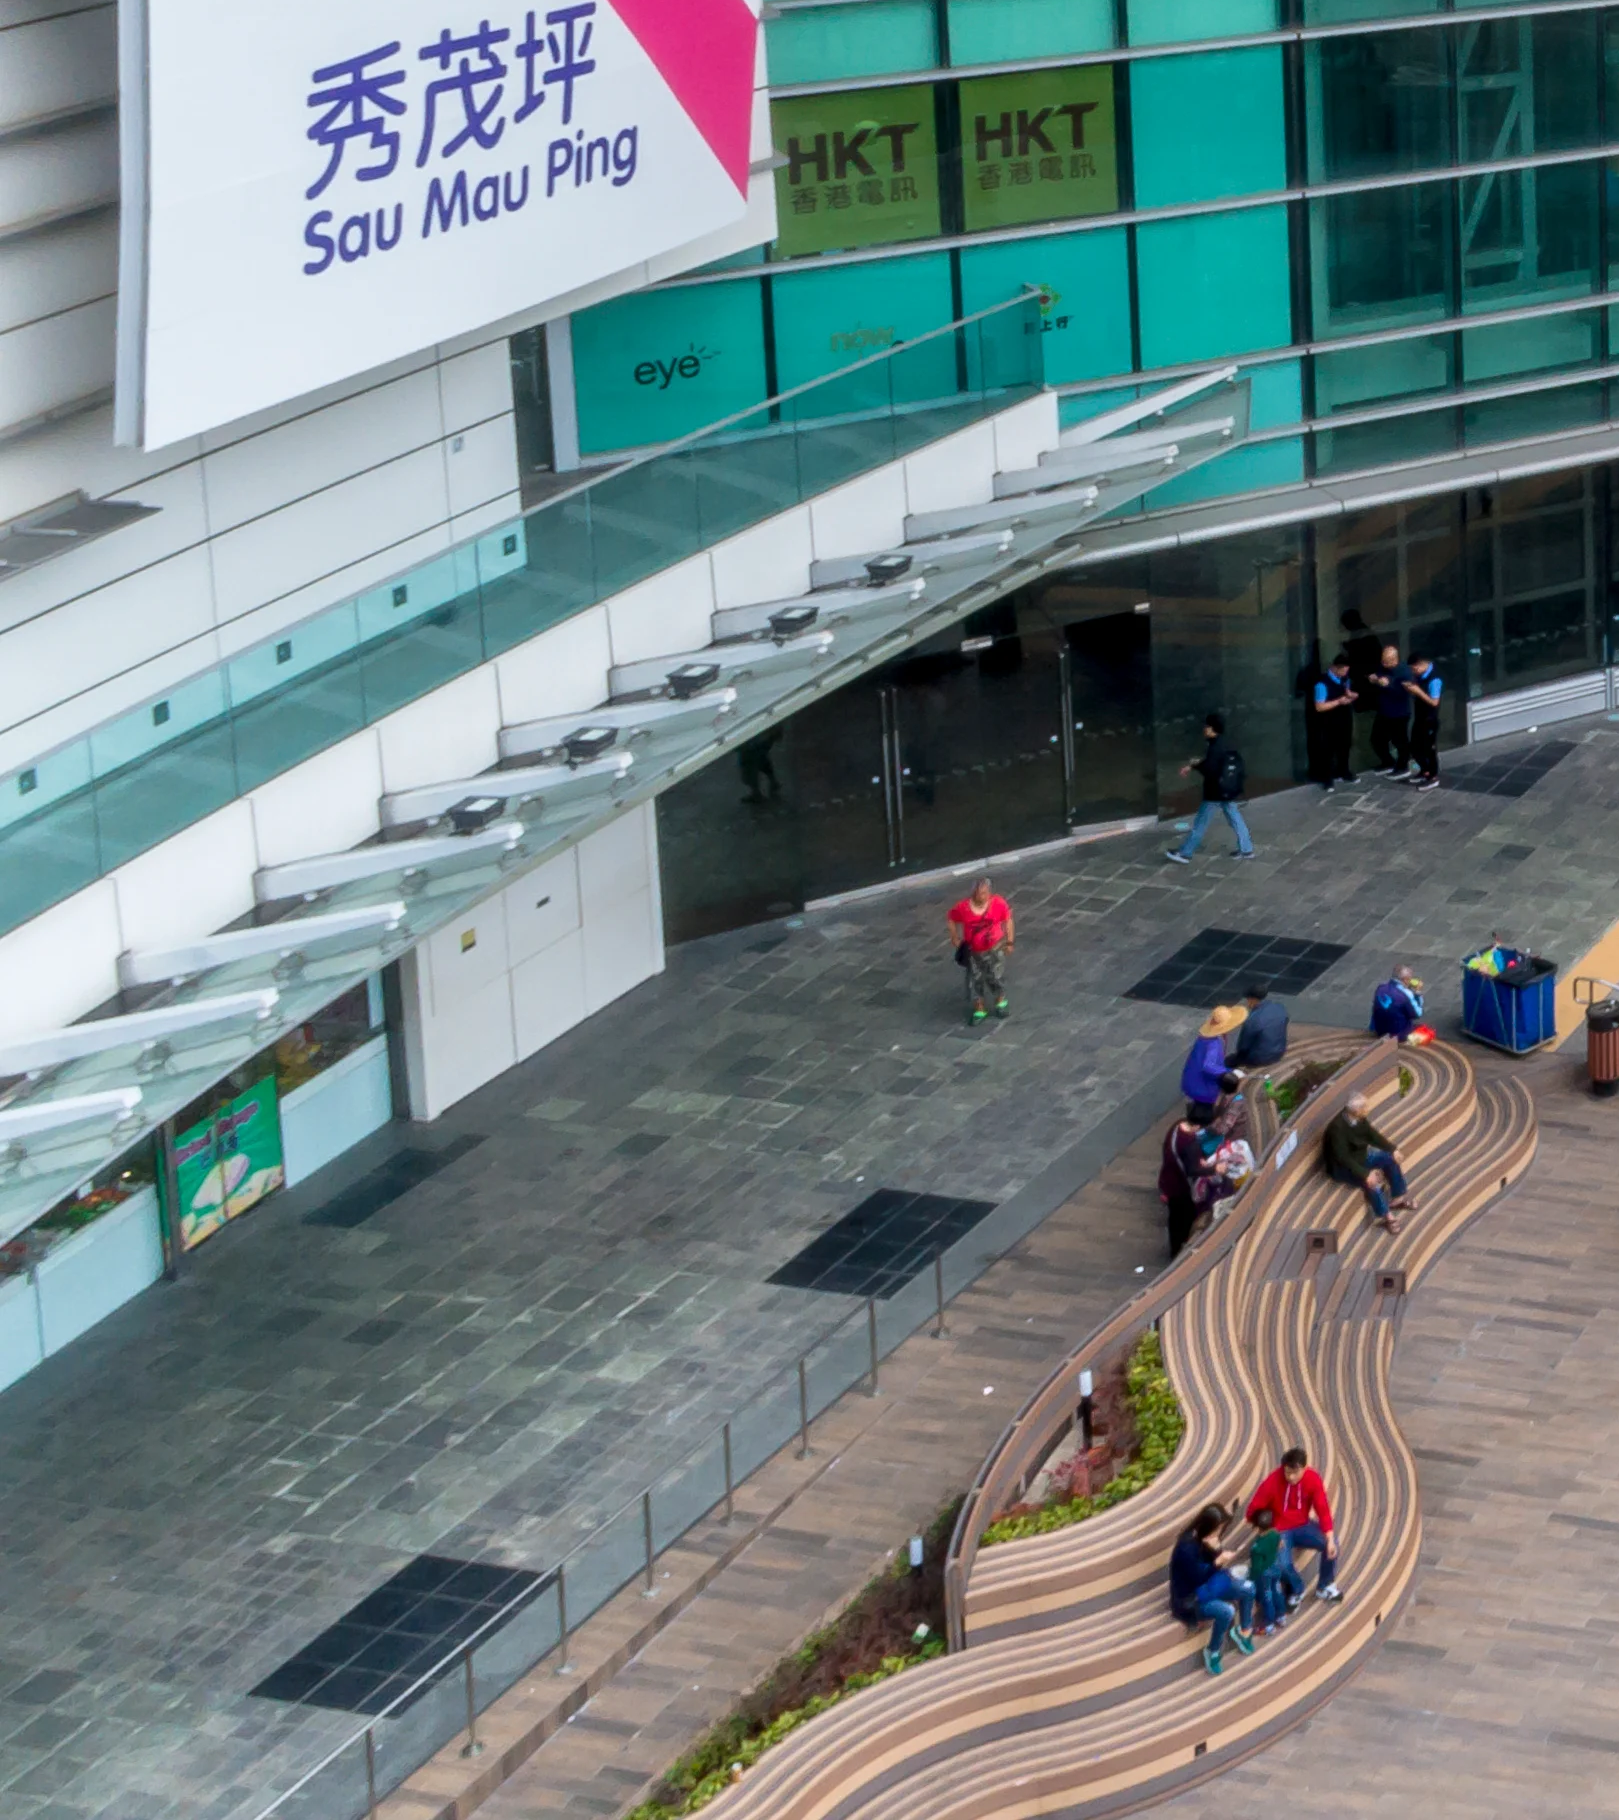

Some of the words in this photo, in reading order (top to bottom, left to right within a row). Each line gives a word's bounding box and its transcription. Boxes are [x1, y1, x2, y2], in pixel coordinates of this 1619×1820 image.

[305, 0, 597, 200] 秀茂坪
[788, 122, 920, 185] HKT
[974, 101, 1099, 162] HKT
[303, 197, 403, 276] Sau
[421, 165, 529, 240] Mau
[547, 124, 639, 197] Ping
[791, 176, 919, 215] 香港電訊
[978, 153, 1097, 190] 香港電訊
[634, 353, 700, 390] eye
